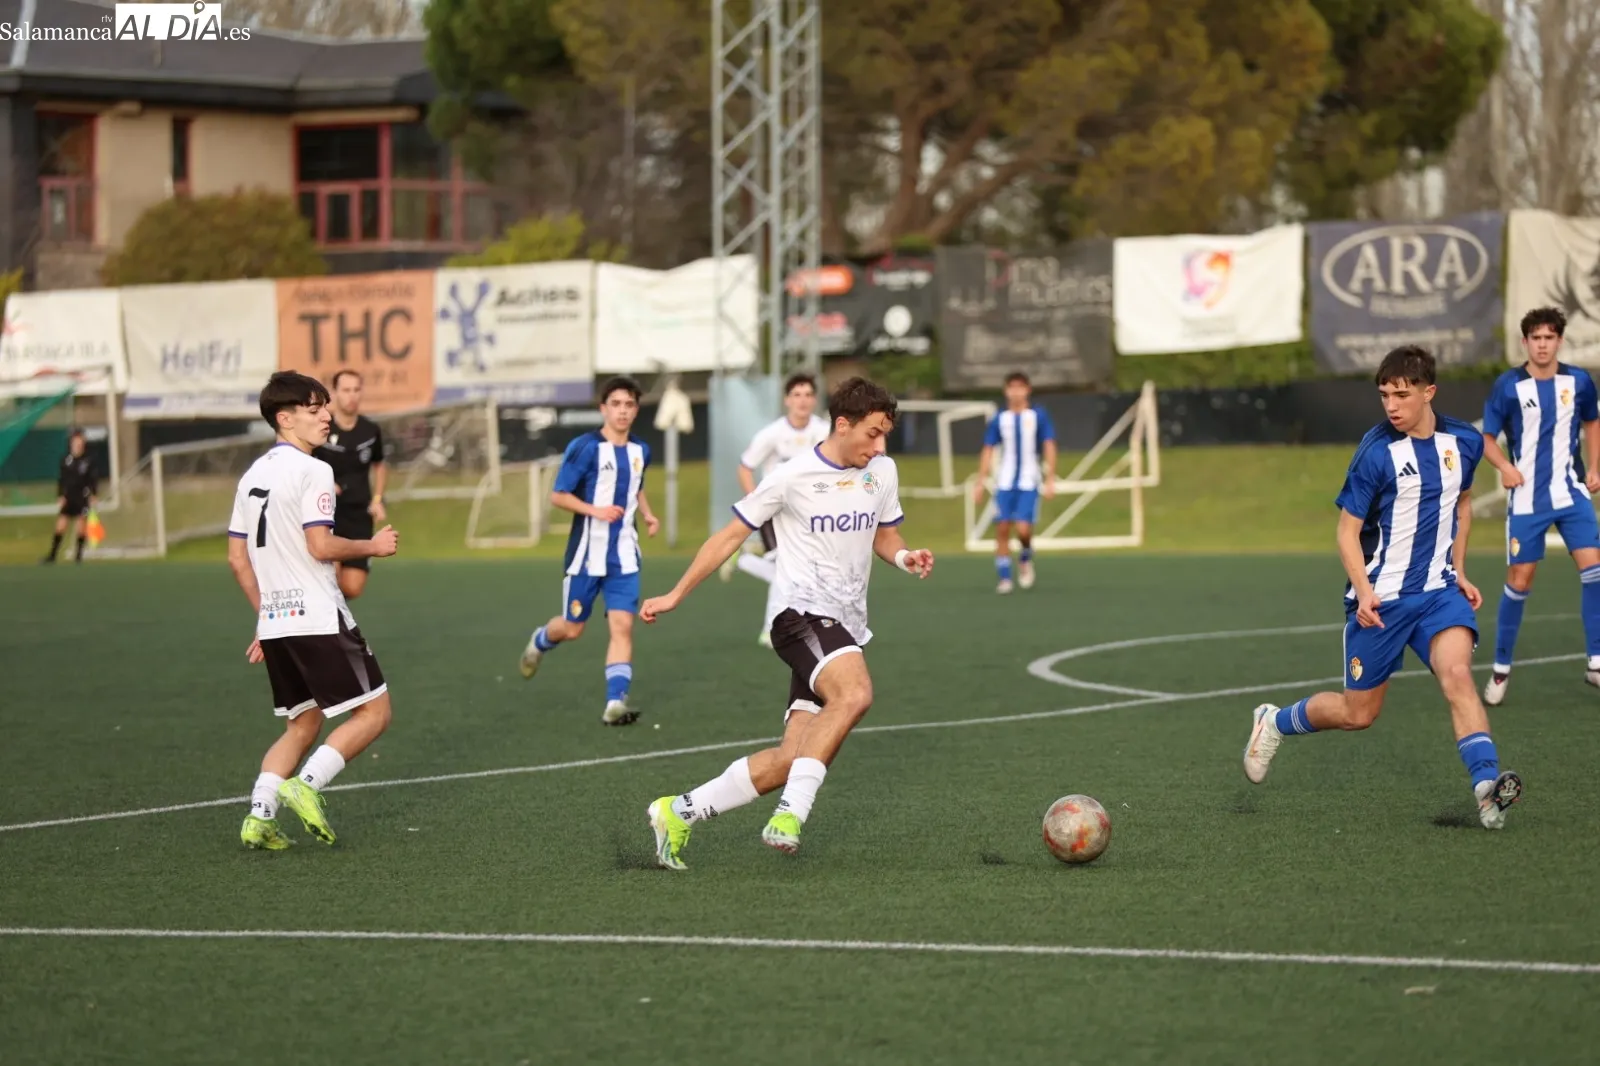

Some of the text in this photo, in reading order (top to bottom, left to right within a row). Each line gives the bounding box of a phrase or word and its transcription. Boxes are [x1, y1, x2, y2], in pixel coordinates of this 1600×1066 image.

[1348, 235, 1470, 295] ARA
[297, 306, 413, 365] THC
[248, 487, 271, 548] 7
[810, 510, 876, 533] meins
